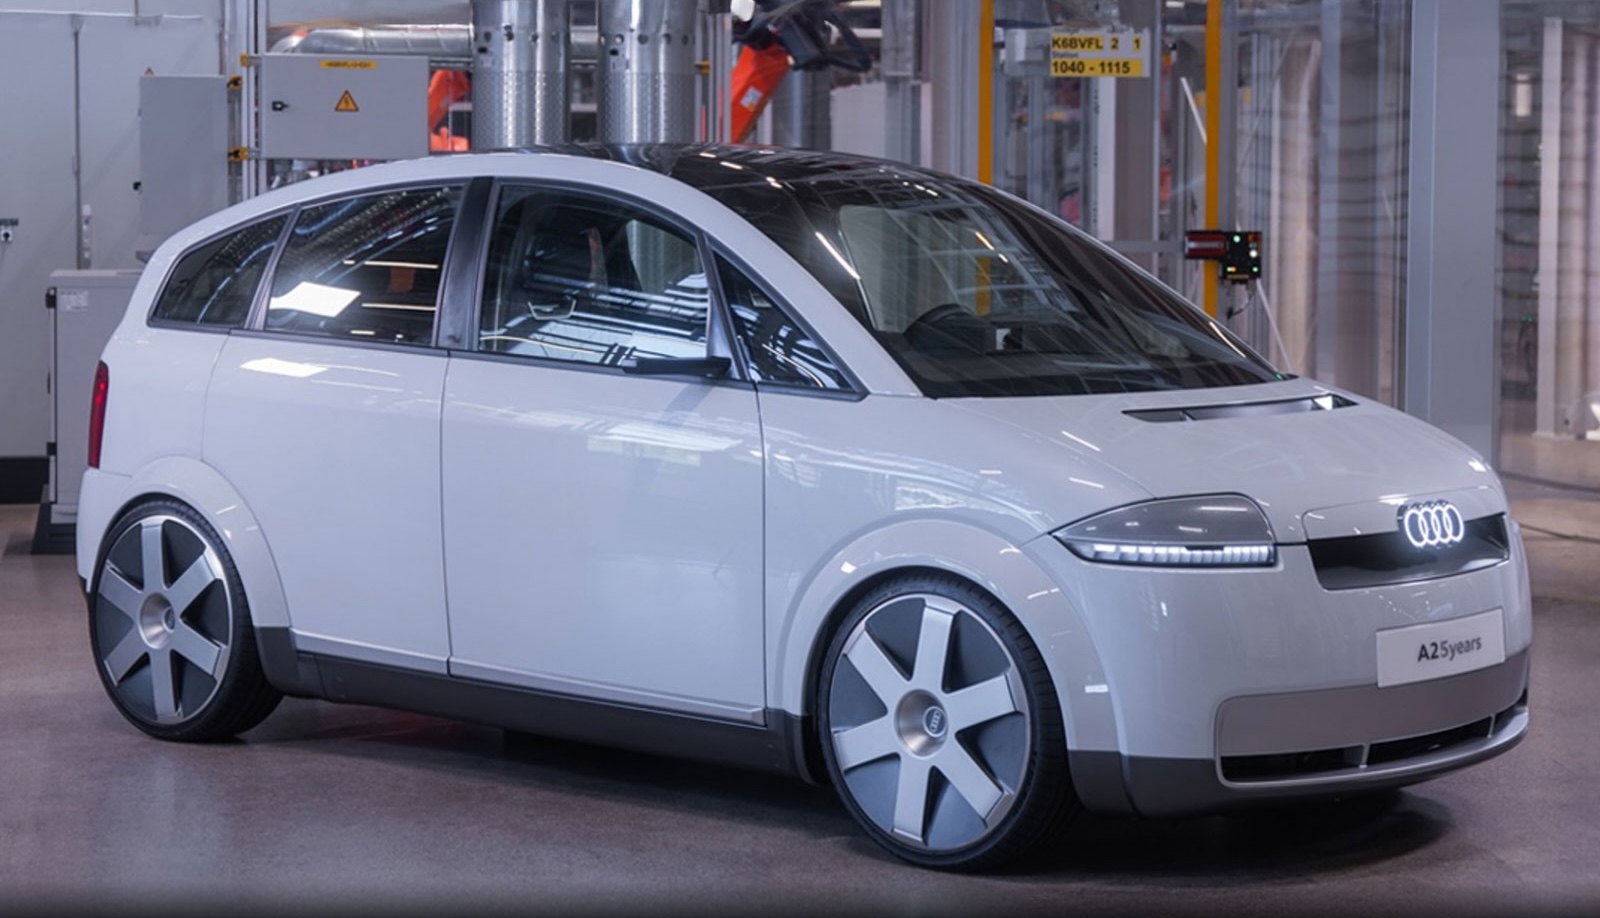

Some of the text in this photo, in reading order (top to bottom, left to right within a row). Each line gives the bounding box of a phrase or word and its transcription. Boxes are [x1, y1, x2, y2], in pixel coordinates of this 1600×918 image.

[1052, 37, 1140, 50] K6BVFL 2 1
[1052, 61, 1085, 74] 1040
[1099, 61, 1130, 75] 1115
